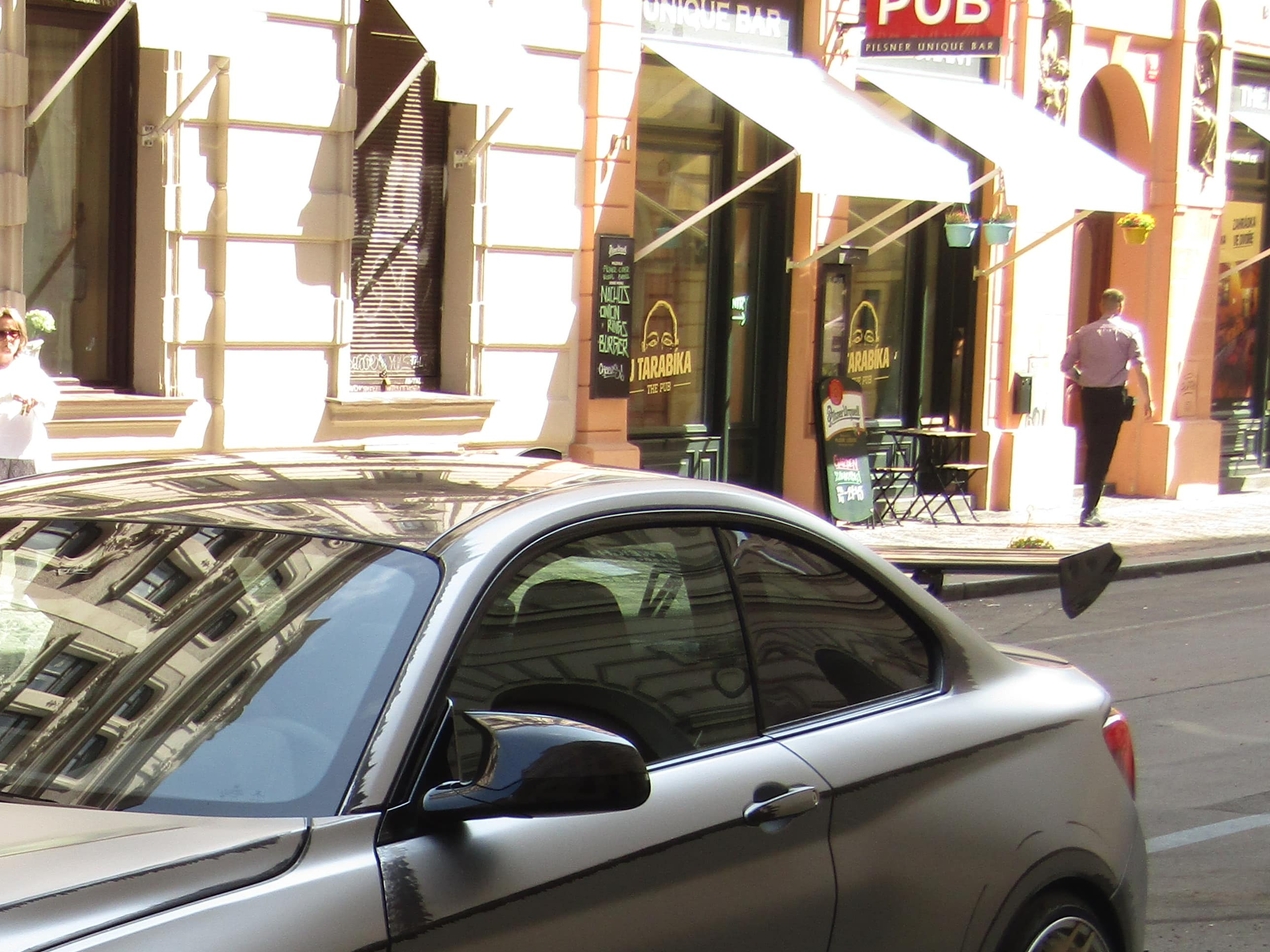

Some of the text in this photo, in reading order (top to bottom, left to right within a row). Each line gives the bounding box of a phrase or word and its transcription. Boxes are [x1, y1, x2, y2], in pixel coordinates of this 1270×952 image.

[643, 0, 780, 38] UNIQUE BAR
[878, 0, 991, 25] PUB
[865, 41, 994, 52] PILSNER UNIQUE BAR
[600, 285, 630, 304] NACHOS
[598, 334, 629, 358] BURGER
[637, 347, 691, 381] TARABÍKA
[847, 344, 890, 374] ARABÍKA
[647, 381, 671, 394] THE PUB
